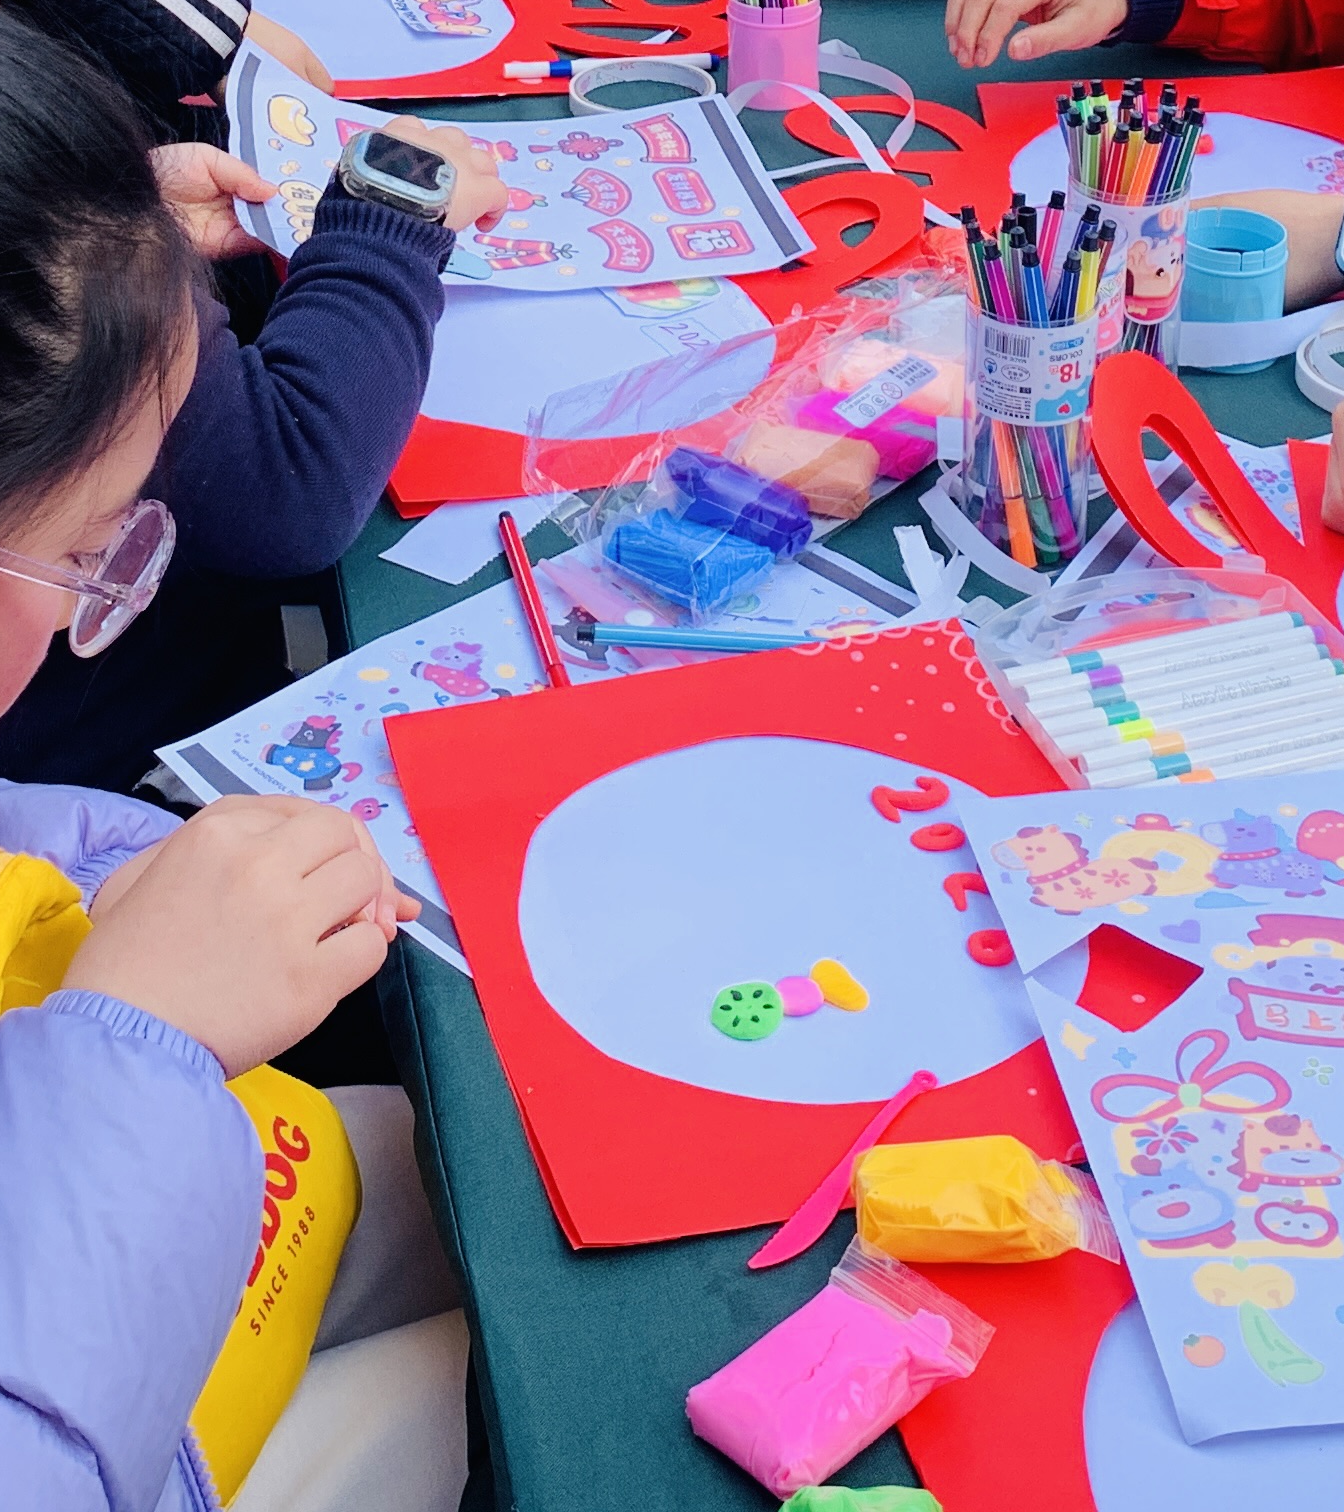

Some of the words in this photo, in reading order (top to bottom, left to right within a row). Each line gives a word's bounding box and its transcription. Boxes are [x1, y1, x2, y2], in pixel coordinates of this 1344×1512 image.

[604, 225, 641, 267] 大吉大利
[1049, 349, 1083, 362] COLORS
[250, 1264, 289, 1336] SINCE
[287, 1205, 316, 1257] 1988
